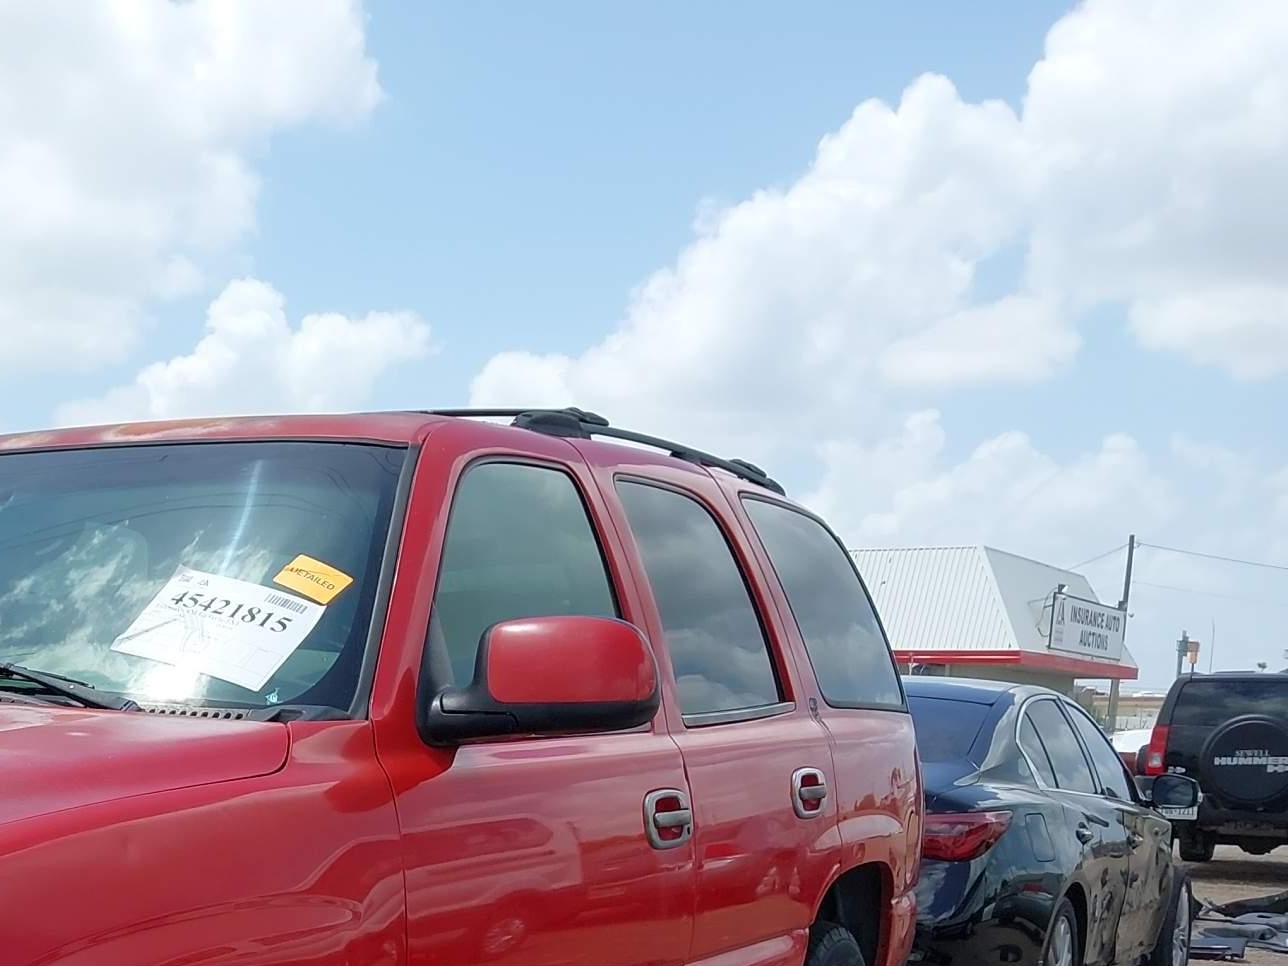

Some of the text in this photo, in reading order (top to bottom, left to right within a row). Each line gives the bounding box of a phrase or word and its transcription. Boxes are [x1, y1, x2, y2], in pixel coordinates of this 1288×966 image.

[170, 590, 294, 632] 45421815
[1070, 605, 1105, 630] INSURANCE
[1104, 613, 1121, 633] AUTO
[1078, 629, 1109, 651] AUCTIONS
[1214, 757, 1288, 765] HUMMER
